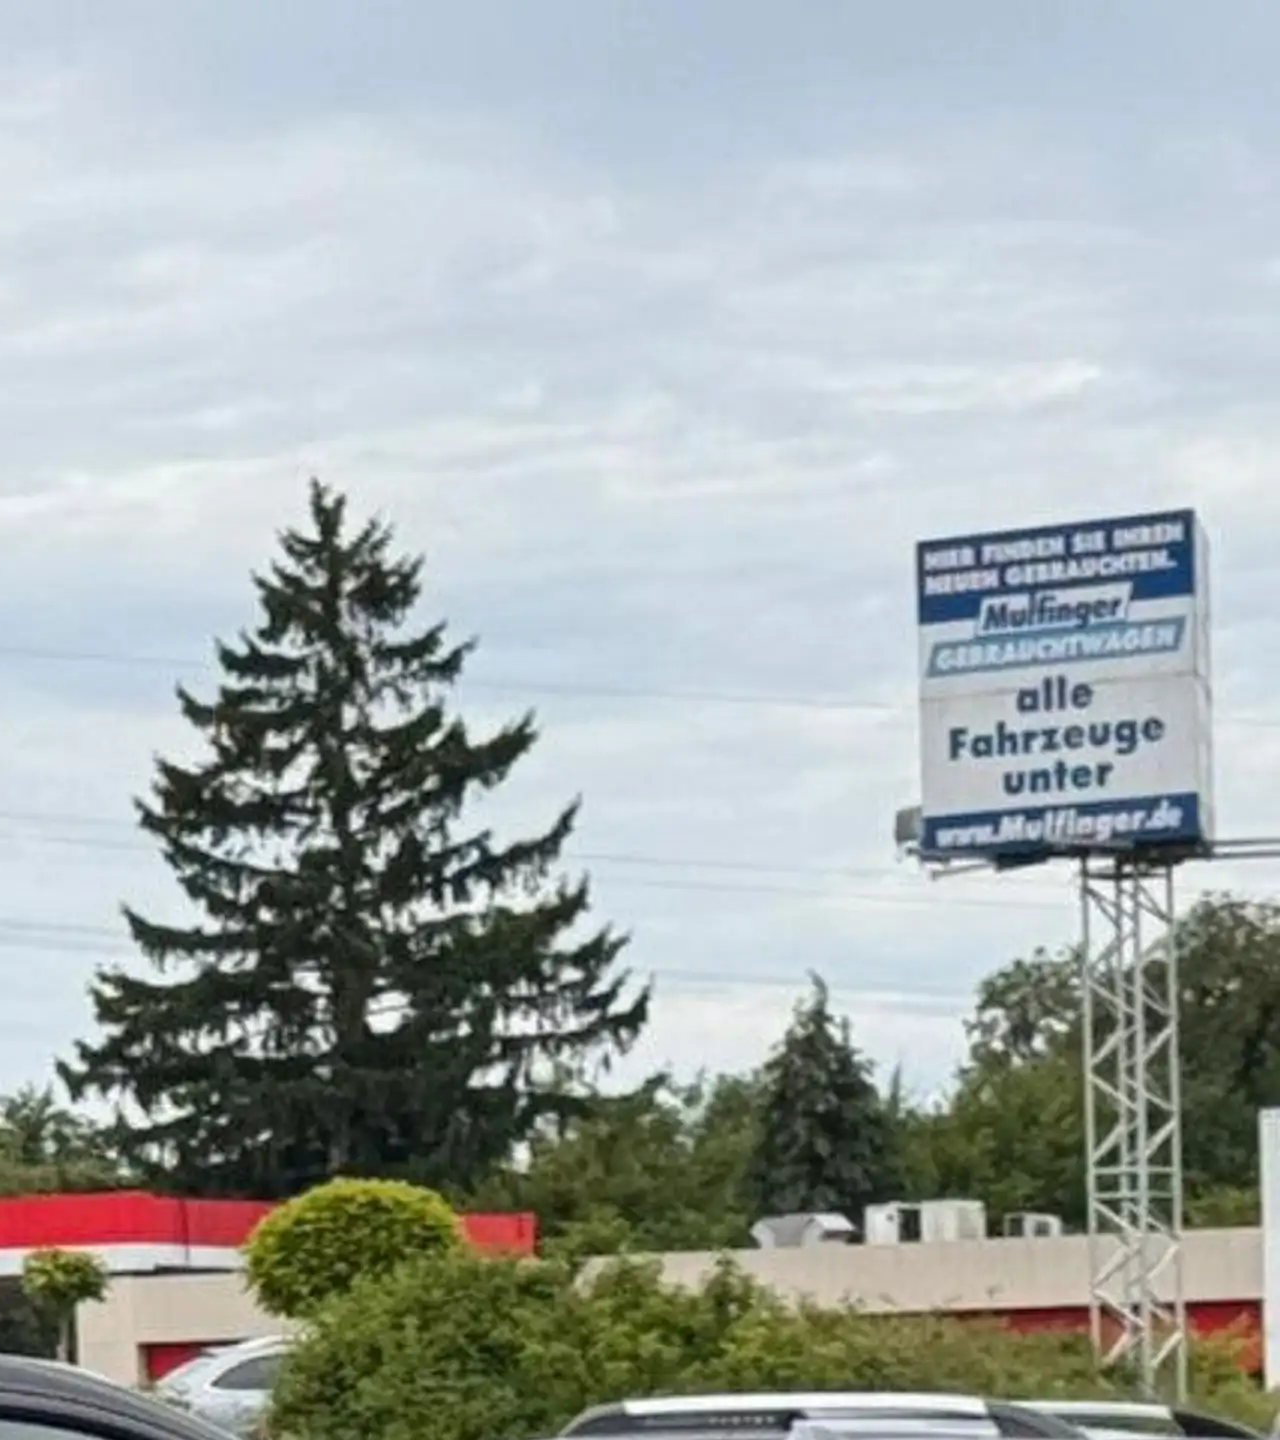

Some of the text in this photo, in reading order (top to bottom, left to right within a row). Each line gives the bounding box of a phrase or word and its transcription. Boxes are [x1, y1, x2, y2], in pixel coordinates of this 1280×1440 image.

[925, 521, 1185, 570] HIER FINDEN SIE IHREN
[925, 568, 999, 595] NEUEN
[983, 594, 1122, 630] Mulfinger
[936, 624, 1178, 671] GEBRAUCHTWAGEN
[1016, 675, 1094, 713] alle
[949, 716, 1165, 761] Fahrzeuge
[1003, 760, 1114, 795] unter
[935, 798, 1184, 849] www.Mulfinger.de
